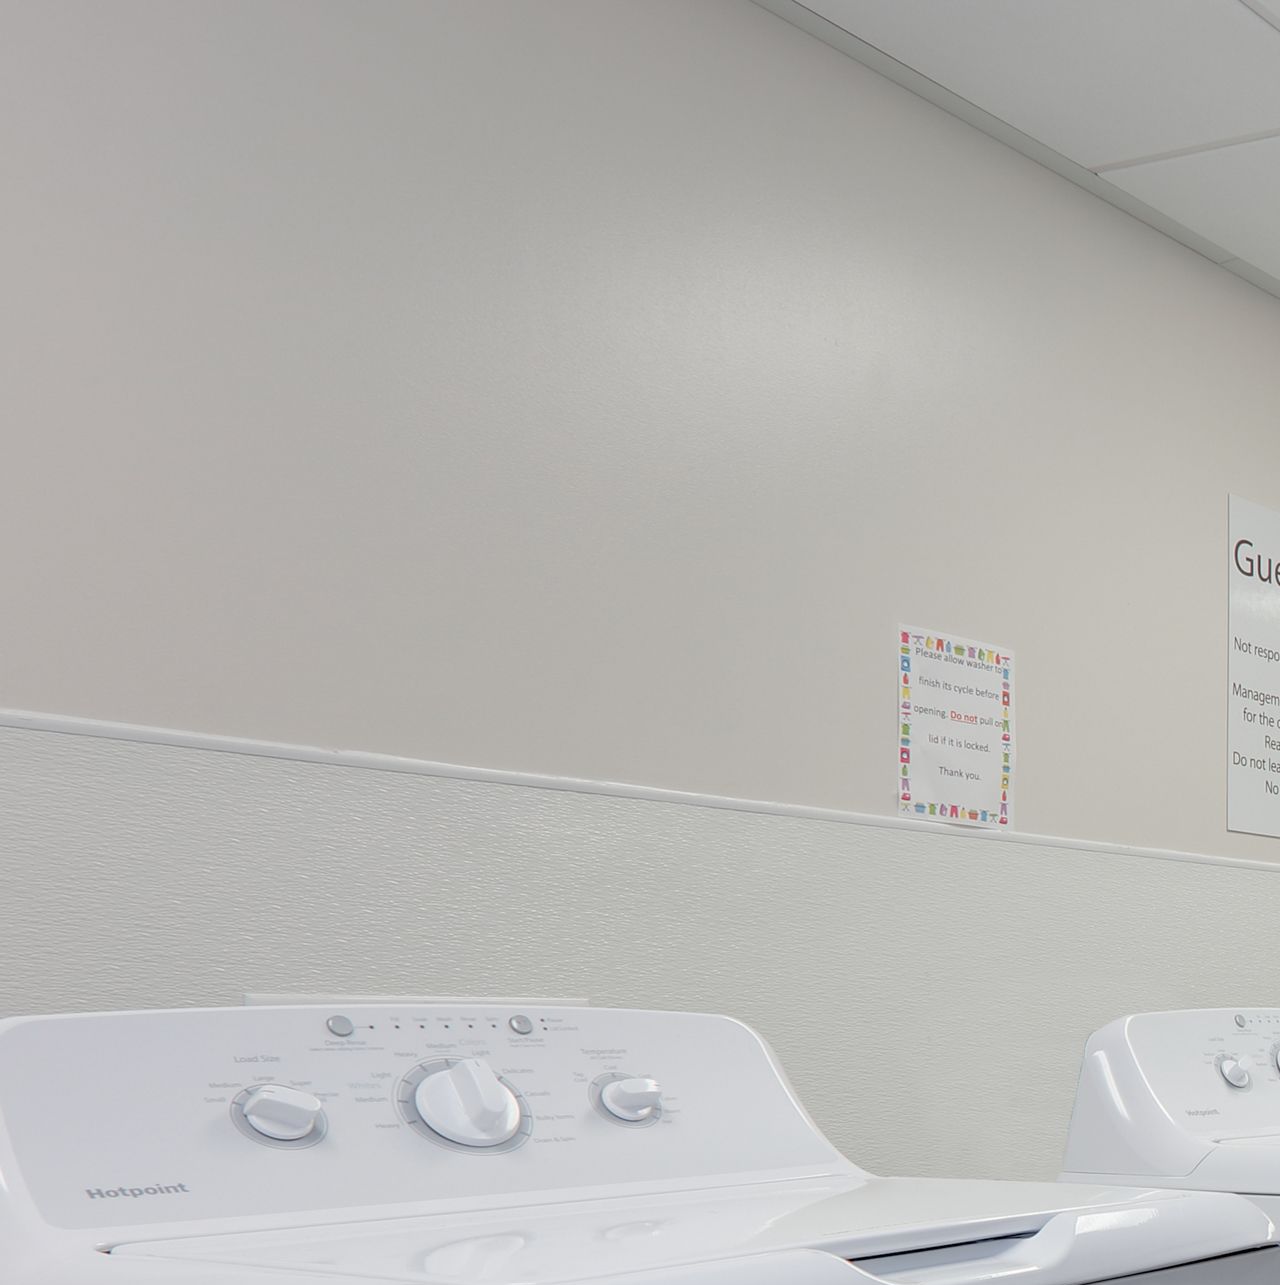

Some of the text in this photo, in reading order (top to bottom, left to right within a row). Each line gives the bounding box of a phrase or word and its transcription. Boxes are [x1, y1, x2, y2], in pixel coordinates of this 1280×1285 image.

[1234, 636, 1252, 654] Not
[915, 647, 1003, 675] Please allow washer to
[918, 676, 1000, 701] finish its cycle before
[913, 705, 948, 720] opening.
[950, 710, 963, 721] Do
[963, 714, 978, 724] not
[979, 717, 994, 726] pull
[1243, 707, 1256, 723] for
[1259, 711, 1275, 728] the
[928, 733, 991, 753] lid if it is locked.
[1232, 751, 1247, 767] Do
[1249, 757, 1266, 771] not
[939, 766, 964, 778] Thank
[1265, 780, 1279, 795] No
[85, 1183, 190, 1199] Hotpoint
